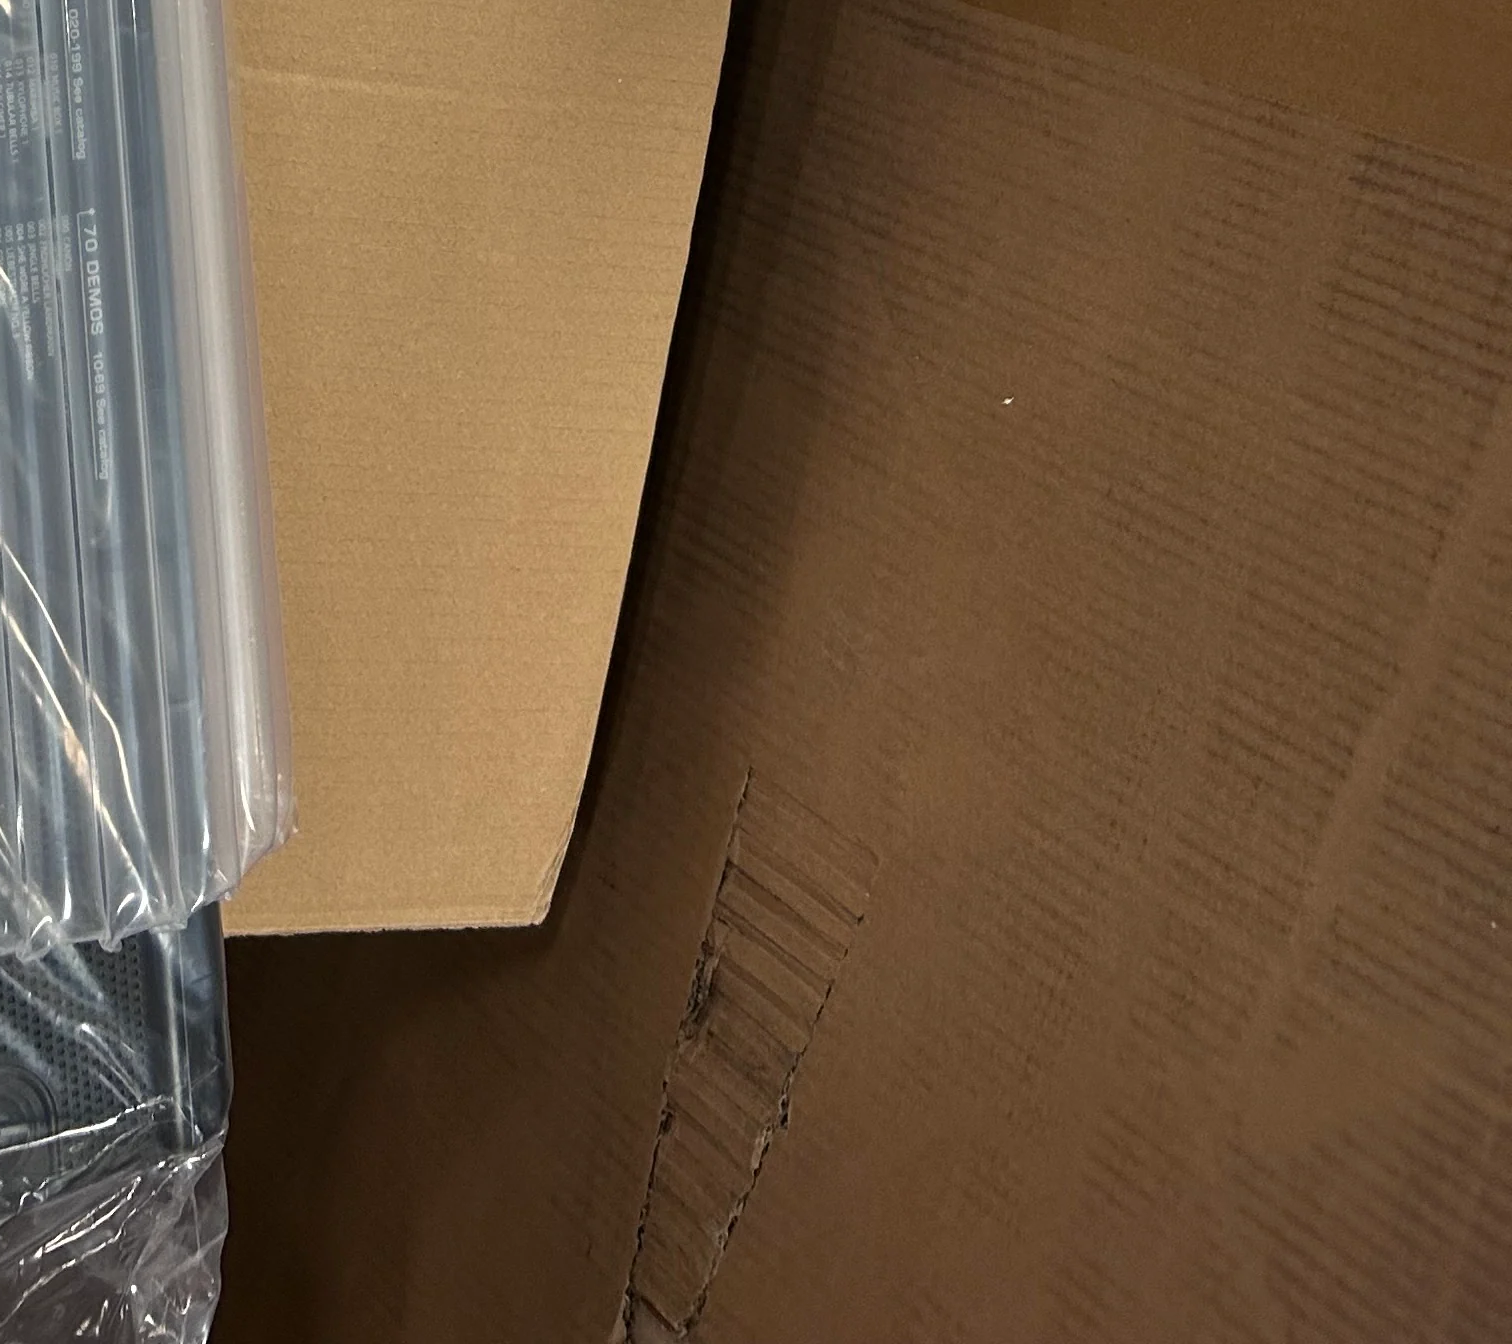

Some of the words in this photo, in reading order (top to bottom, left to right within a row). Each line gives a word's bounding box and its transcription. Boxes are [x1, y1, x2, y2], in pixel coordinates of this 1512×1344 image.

[71, 77, 84, 104] See
[7, 128, 18, 157] BELLS
[72, 108, 87, 160] catalog
[83, 224, 98, 253] 70
[27, 243, 38, 274] JINGLE
[30, 274, 40, 304] BELLS
[85, 260, 103, 336] DEMOS
[94, 398, 108, 424] See
[95, 429, 111, 480] catalog
